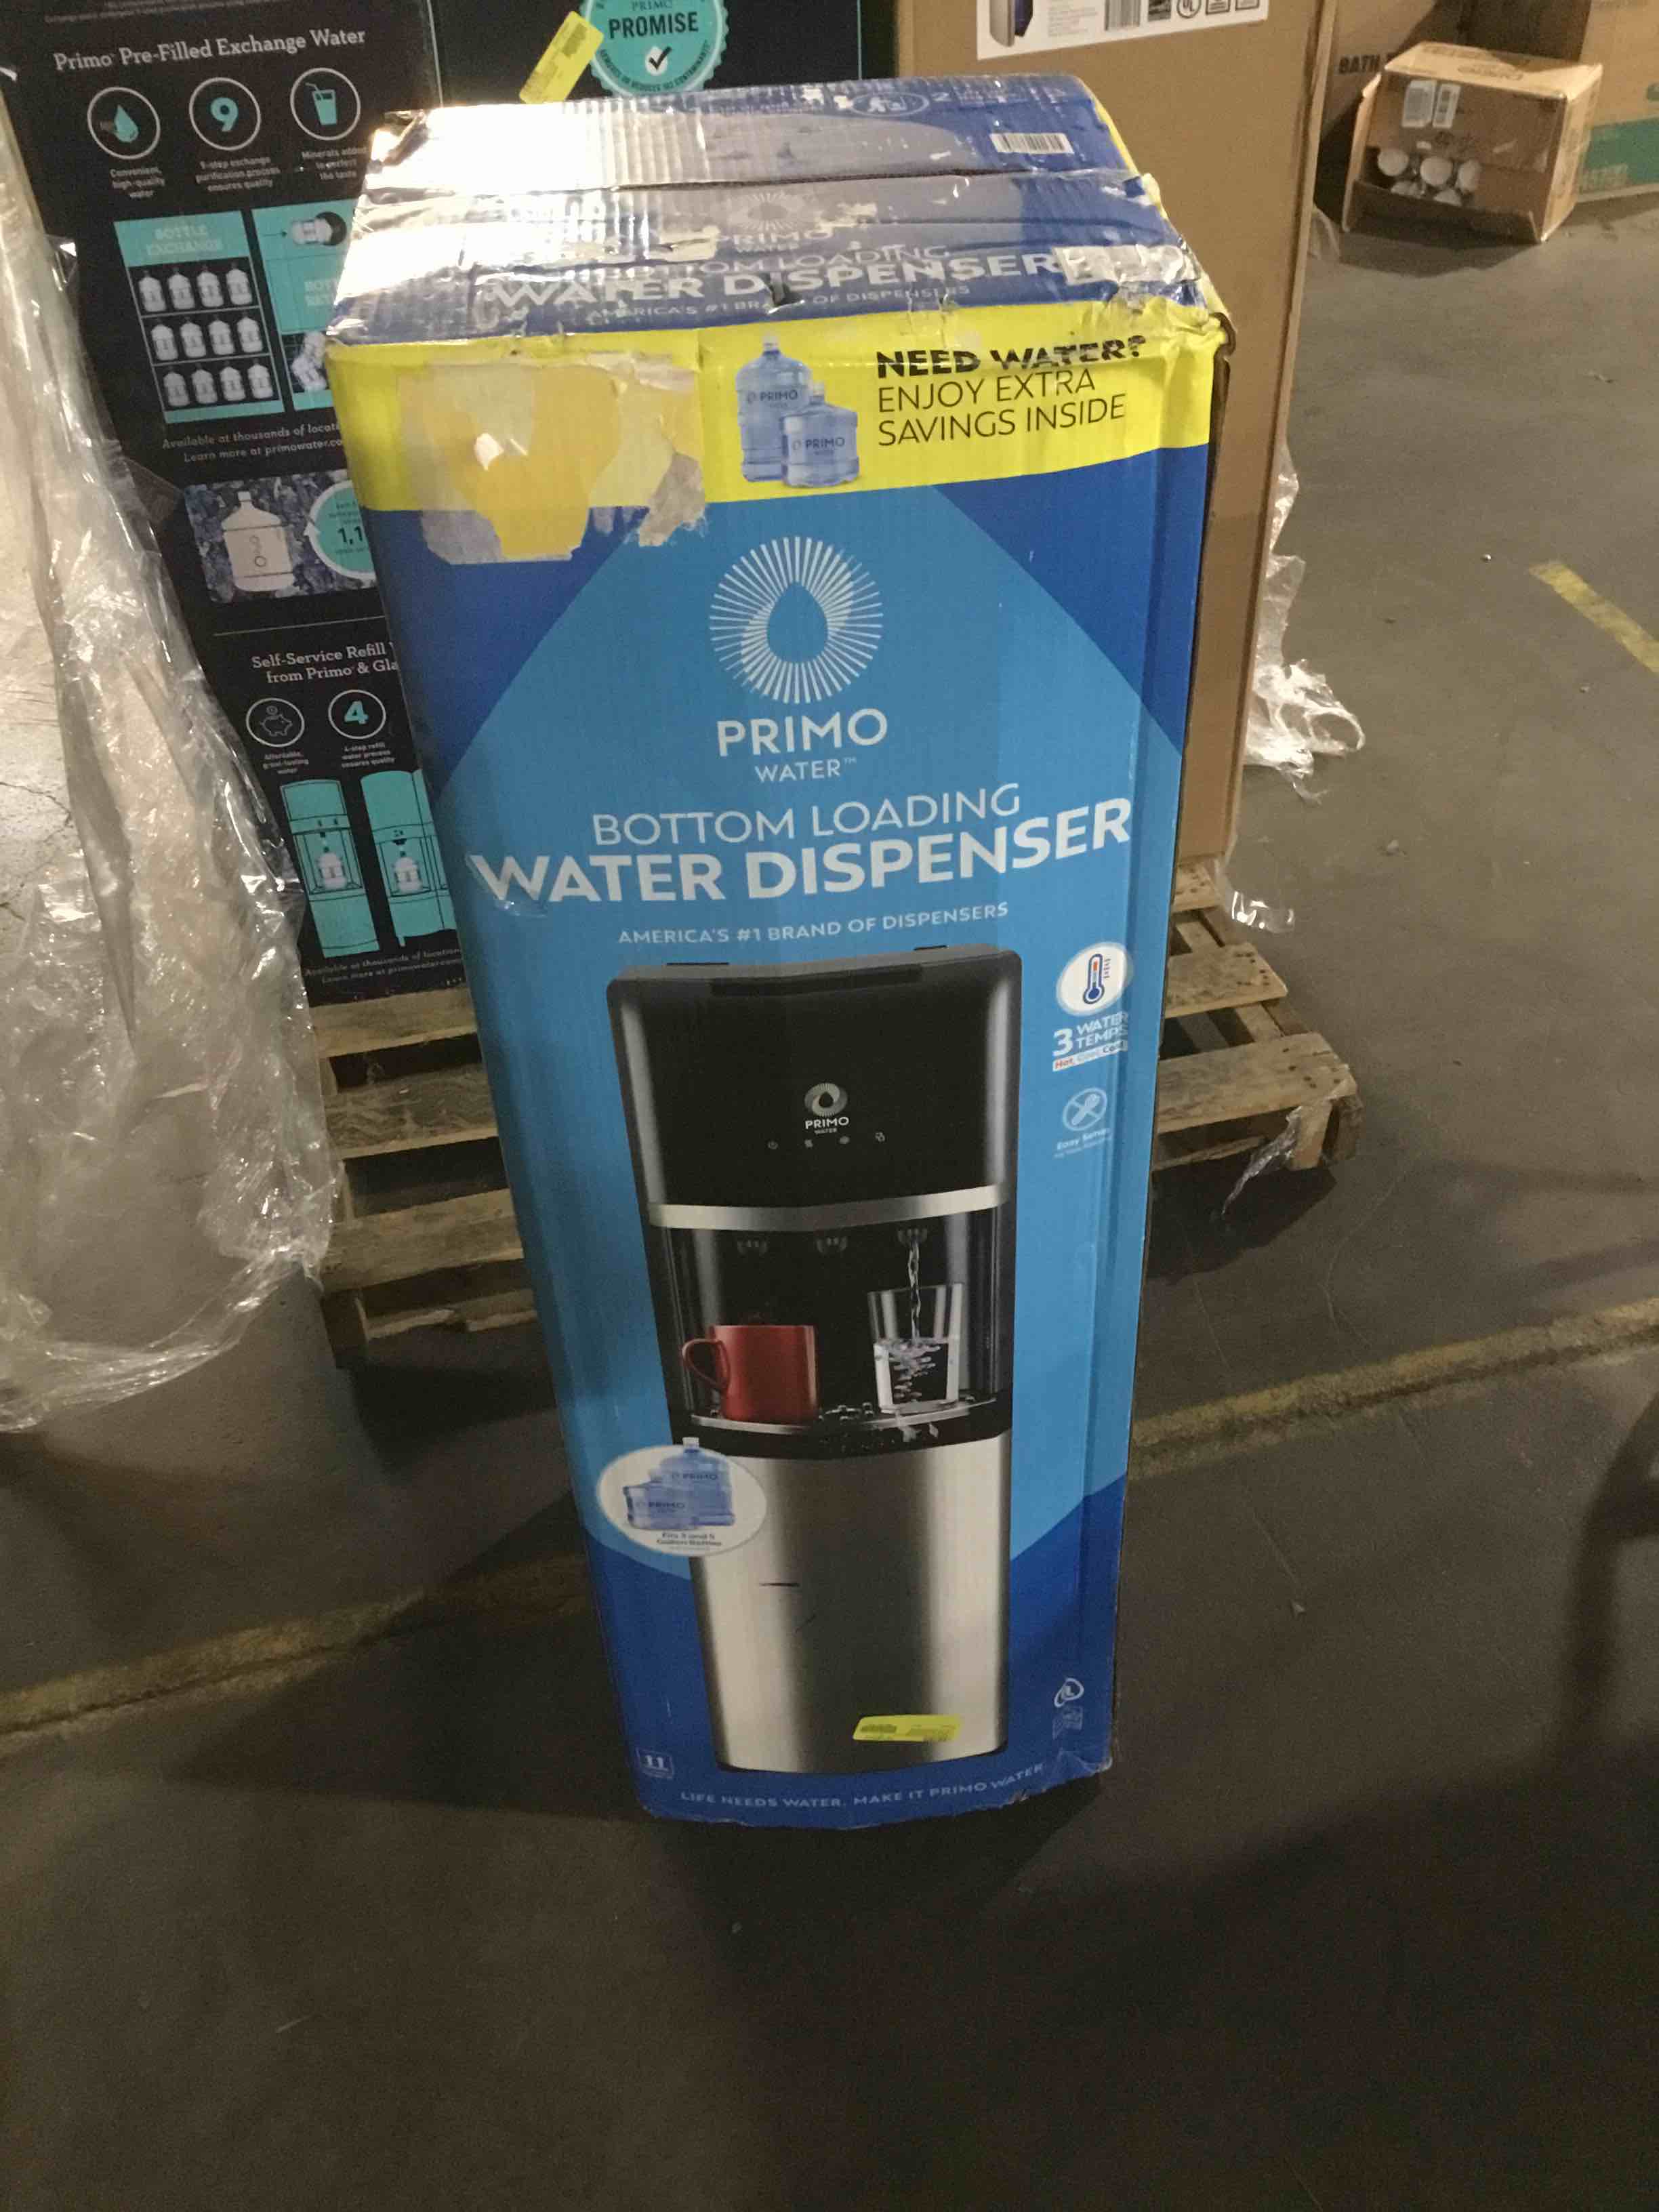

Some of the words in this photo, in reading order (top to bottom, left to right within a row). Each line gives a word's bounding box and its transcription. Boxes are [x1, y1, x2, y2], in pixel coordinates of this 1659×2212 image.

[609, 12, 699, 39] PROMISE
[119, 41, 211, 66] Pre-Filled
[216, 34, 306, 56] Exchange
[310, 28, 366, 47] Water
[210, 97, 239, 131] 9
[778, 244, 950, 270] LOADING
[487, 275, 705, 306] WATER
[724, 252, 1063, 296] DISPENSER
[813, 293, 841, 305] OF
[876, 348, 981, 380] NEED
[989, 335, 1147, 371] WATER?
[760, 390, 798, 401] PRIMO
[878, 378, 985, 413] ENJOY
[997, 368, 1096, 402] EXTRA
[219, 434, 230, 444] at
[233, 427, 291, 441] thousands
[293, 424, 305, 437] of
[878, 410, 1016, 447] SAVINGS
[1027, 394, 1126, 428] INSIDE
[184, 452, 216, 464] Learn
[219, 450, 247, 459] more
[250, 447, 262, 456] at
[805, 436, 846, 449] PRIMO
[251, 649, 343, 669] Self-Service
[346, 642, 386, 659] Refill
[266, 670, 304, 684] from
[356, 661, 369, 675] &
[344, 701, 369, 724] 4
[717, 708, 888, 757] PRIMO
[594, 810, 794, 846] BOTTOM
[811, 783, 1020, 836] LOADING
[466, 851, 729, 903] WATER
[745, 797, 1132, 899] DISPENSER
[618, 926, 729, 945] AMERICA'S
[735, 926, 762, 941] #1
[768, 920, 841, 941] BRAND
[848, 916, 878, 934] OF
[882, 901, 1009, 930] DISPENSERS
[1052, 1028, 1073, 1057] 3
[1077, 1011, 1128, 1036] WATER
[805, 1116, 850, 1130] PRIMO
[680, 1791, 716, 1803] LIFE
[721, 1795, 778, 1807] NEEDS
[853, 1791, 903, 1805] MAKE
[909, 1789, 925, 1800] IT
[929, 1781, 988, 1797] PRIMO
[989, 1762, 1044, 1790] WATER
